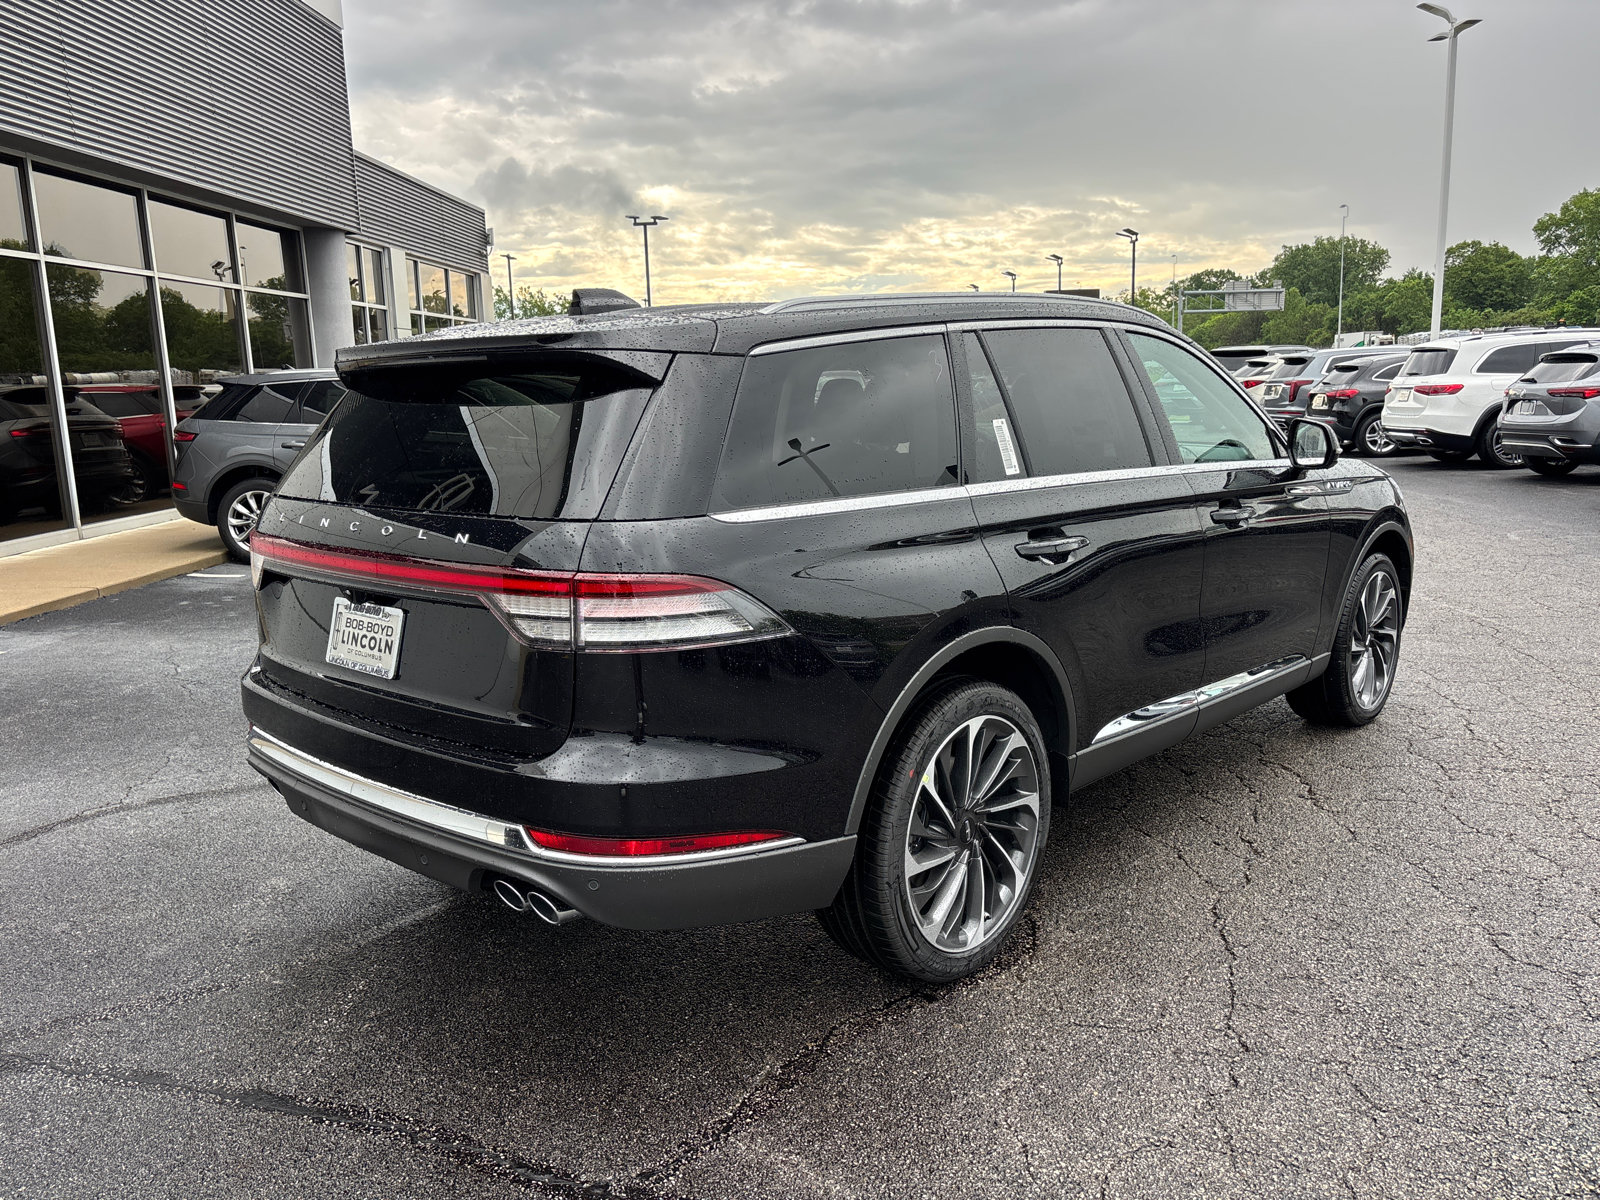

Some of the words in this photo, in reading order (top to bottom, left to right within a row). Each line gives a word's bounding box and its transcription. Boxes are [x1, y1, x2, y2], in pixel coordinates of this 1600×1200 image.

[279, 513, 470, 544] LINCOLN
[345, 617, 394, 637] BOB-BOYD
[341, 629, 394, 655] LINCOLN
[328, 655, 350, 666] LINCOLN
[351, 661, 358, 669] OF
[358, 663, 389, 677] COLUMBUS
[355, 649, 382, 661] COLUMBUS
